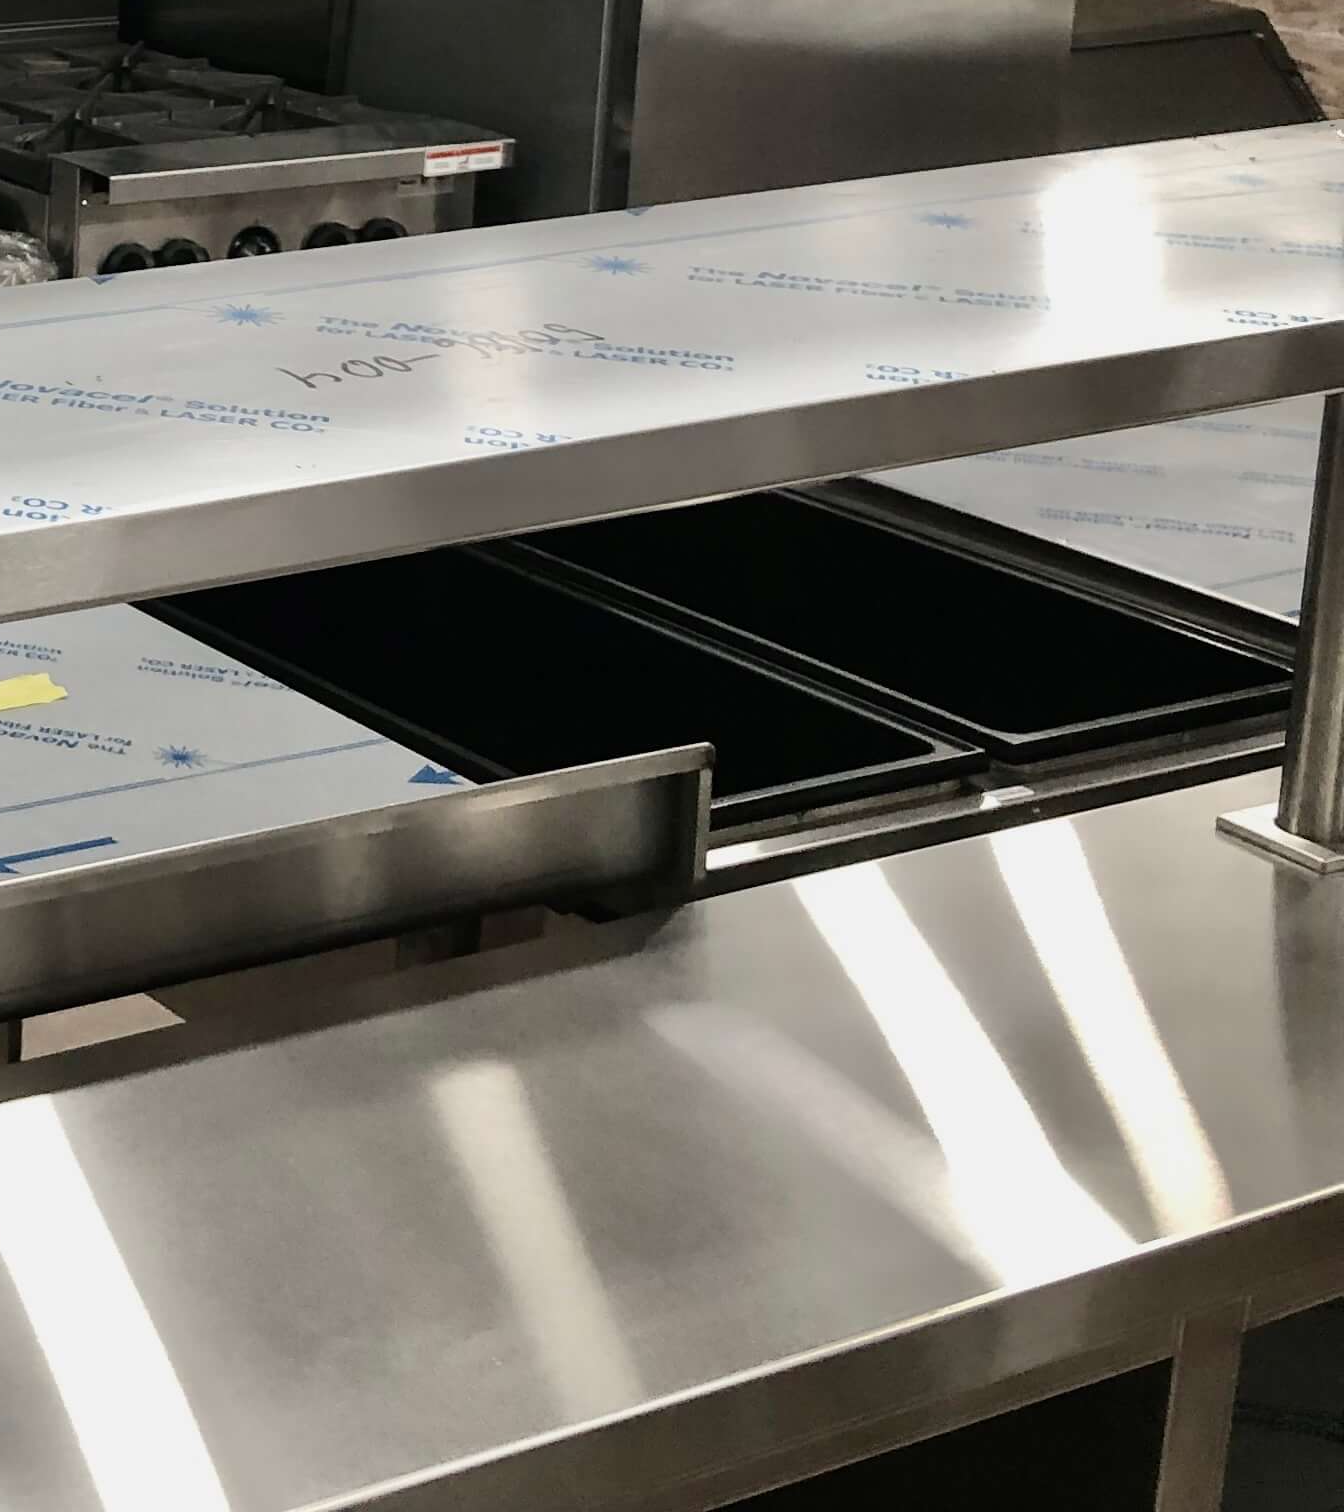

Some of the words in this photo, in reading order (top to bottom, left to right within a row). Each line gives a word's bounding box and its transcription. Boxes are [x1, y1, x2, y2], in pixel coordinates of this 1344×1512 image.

[50, 396, 129, 413] Fiber
[160, 408, 259, 427] LASER
[183, 399, 331, 424] Solution
